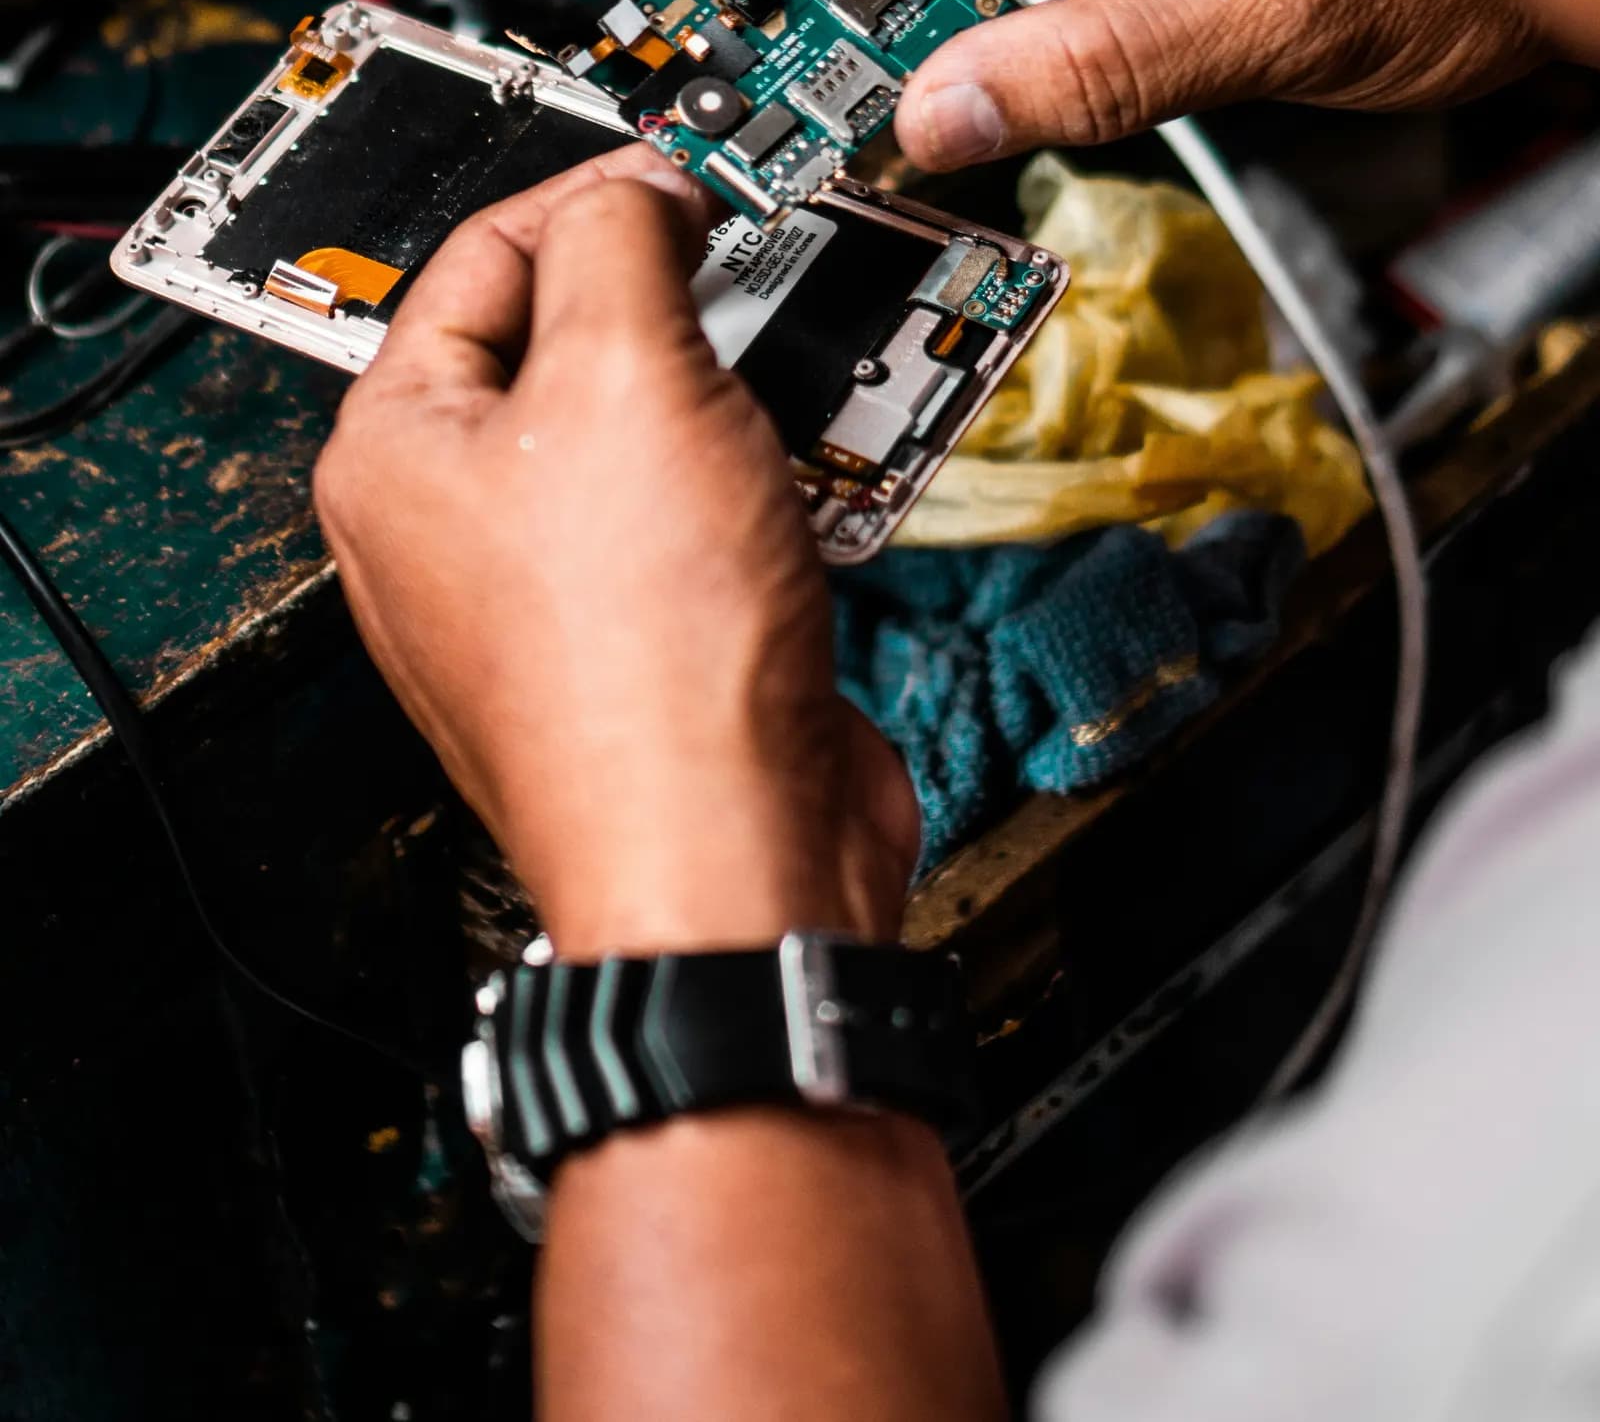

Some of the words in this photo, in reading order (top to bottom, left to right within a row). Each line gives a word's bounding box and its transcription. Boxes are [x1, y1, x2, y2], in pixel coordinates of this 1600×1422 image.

[720, 231, 763, 273] NTC
[732, 265, 757, 286] TYPE
[749, 228, 786, 270] APPROVED
[759, 263, 793, 300] Designed
[788, 254, 798, 265] in
[793, 233, 817, 257] Korea
